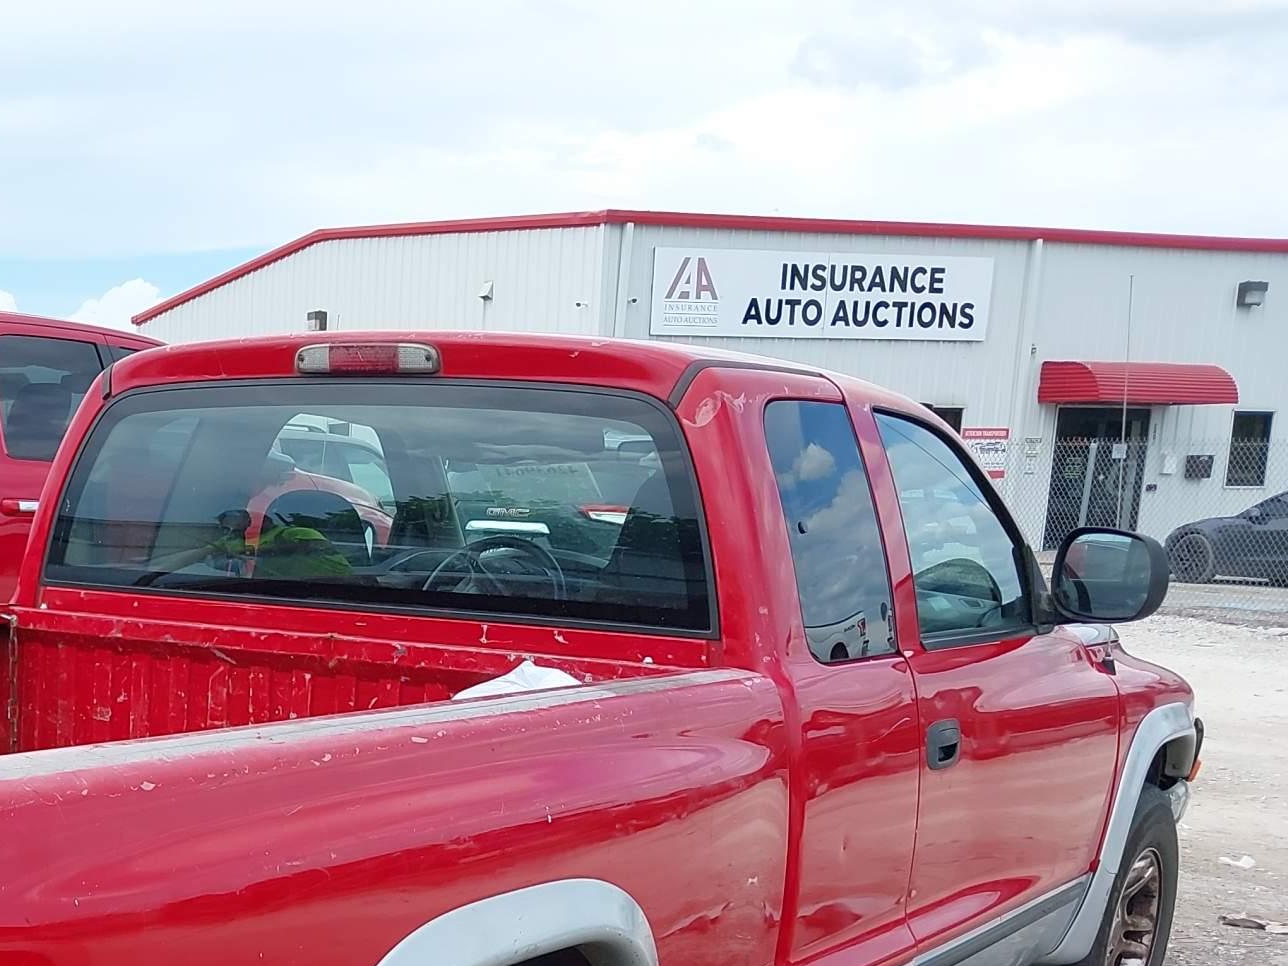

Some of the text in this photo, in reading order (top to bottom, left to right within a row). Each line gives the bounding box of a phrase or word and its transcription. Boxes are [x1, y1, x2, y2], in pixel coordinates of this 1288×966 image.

[780, 263, 946, 294] INSURANCE
[664, 304, 717, 312] INSURANCE
[742, 298, 974, 329] AUTO AUCTIONS
[664, 316, 718, 324] AUTO AUCTIONS
[486, 507, 530, 517] GMC
